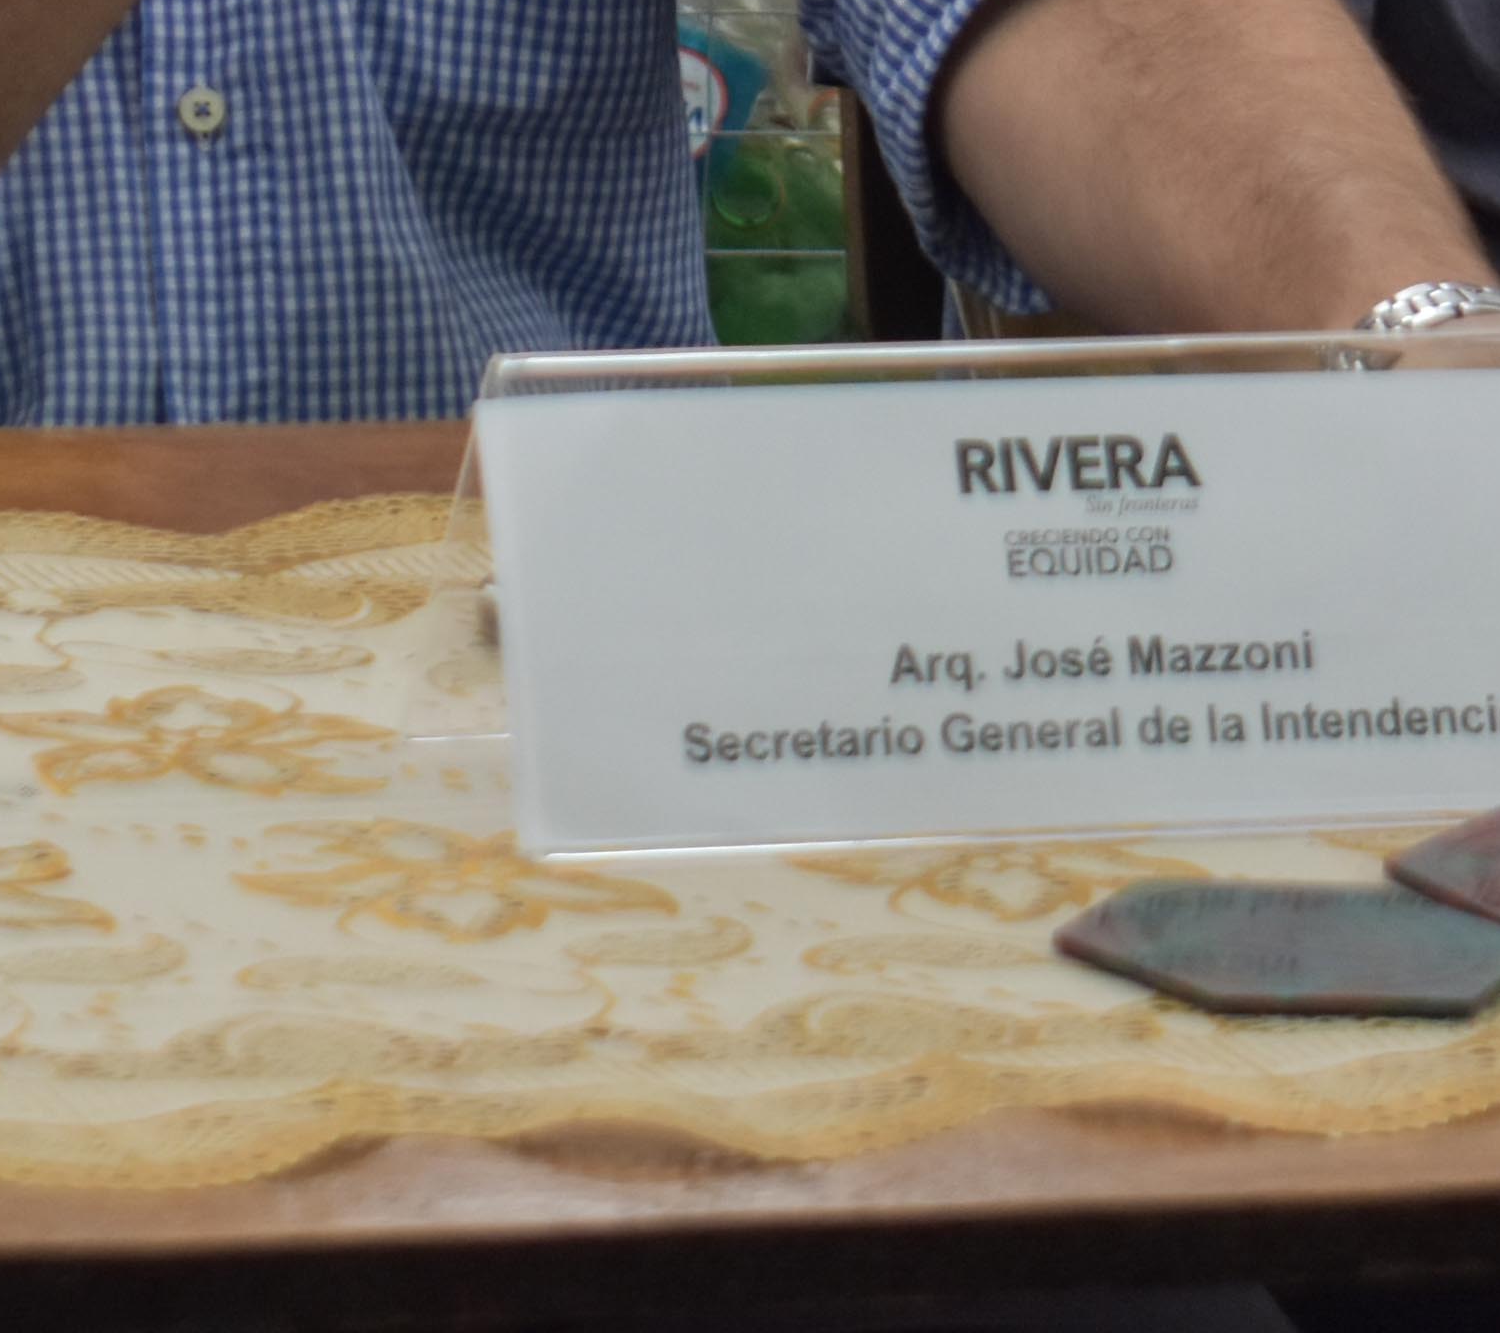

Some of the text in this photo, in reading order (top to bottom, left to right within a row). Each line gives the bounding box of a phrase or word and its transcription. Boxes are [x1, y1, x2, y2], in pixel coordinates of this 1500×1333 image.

[955, 433, 1203, 494] RIVERA
[1006, 542, 1175, 579] EQUIDAD
[890, 631, 1316, 692] Arq. José Mazzoni
[683, 713, 926, 764] Secretario
[939, 704, 1121, 755] General
[1136, 704, 1193, 747] de
[1206, 702, 1246, 745] la
